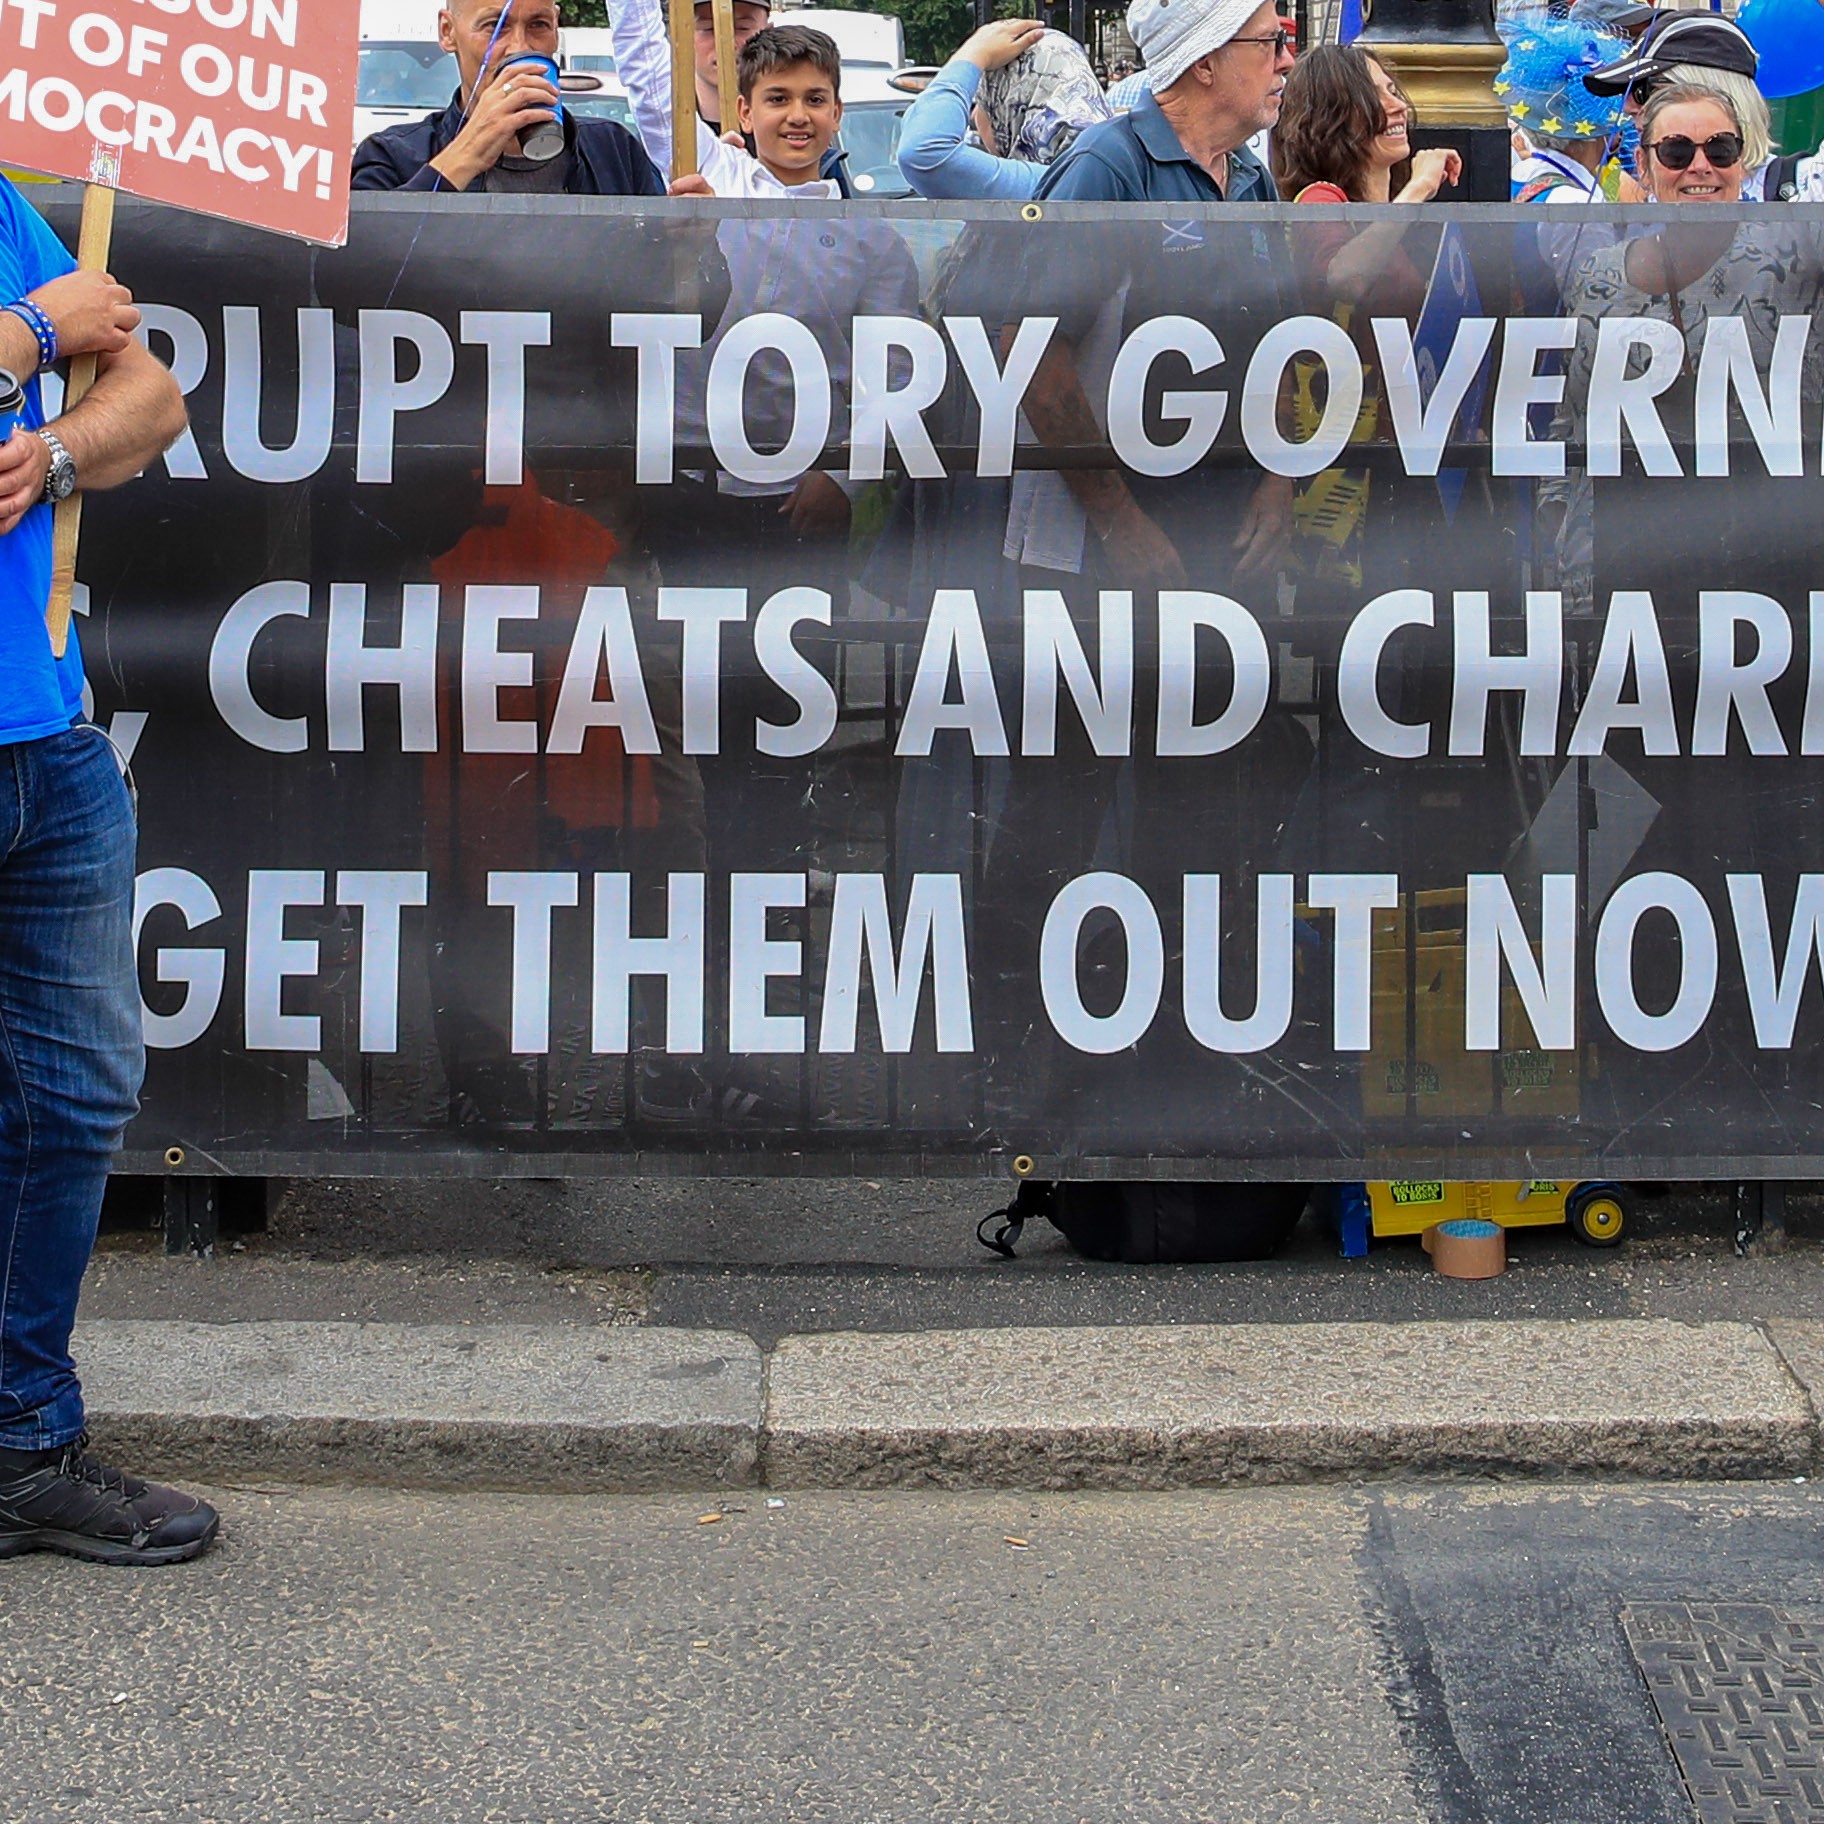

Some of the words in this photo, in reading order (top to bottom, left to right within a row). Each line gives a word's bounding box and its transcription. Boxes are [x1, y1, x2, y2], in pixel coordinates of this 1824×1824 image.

[69, 12, 169, 78] OF
[180, 43, 328, 128] OUR
[612, 312, 1058, 483] TORY
[209, 579, 838, 757] CHEATS
[894, 588, 1271, 757] AND
[132, 867, 428, 1052] GET
[486, 870, 975, 1054] THEM
[1038, 871, 1399, 1054] OUT
